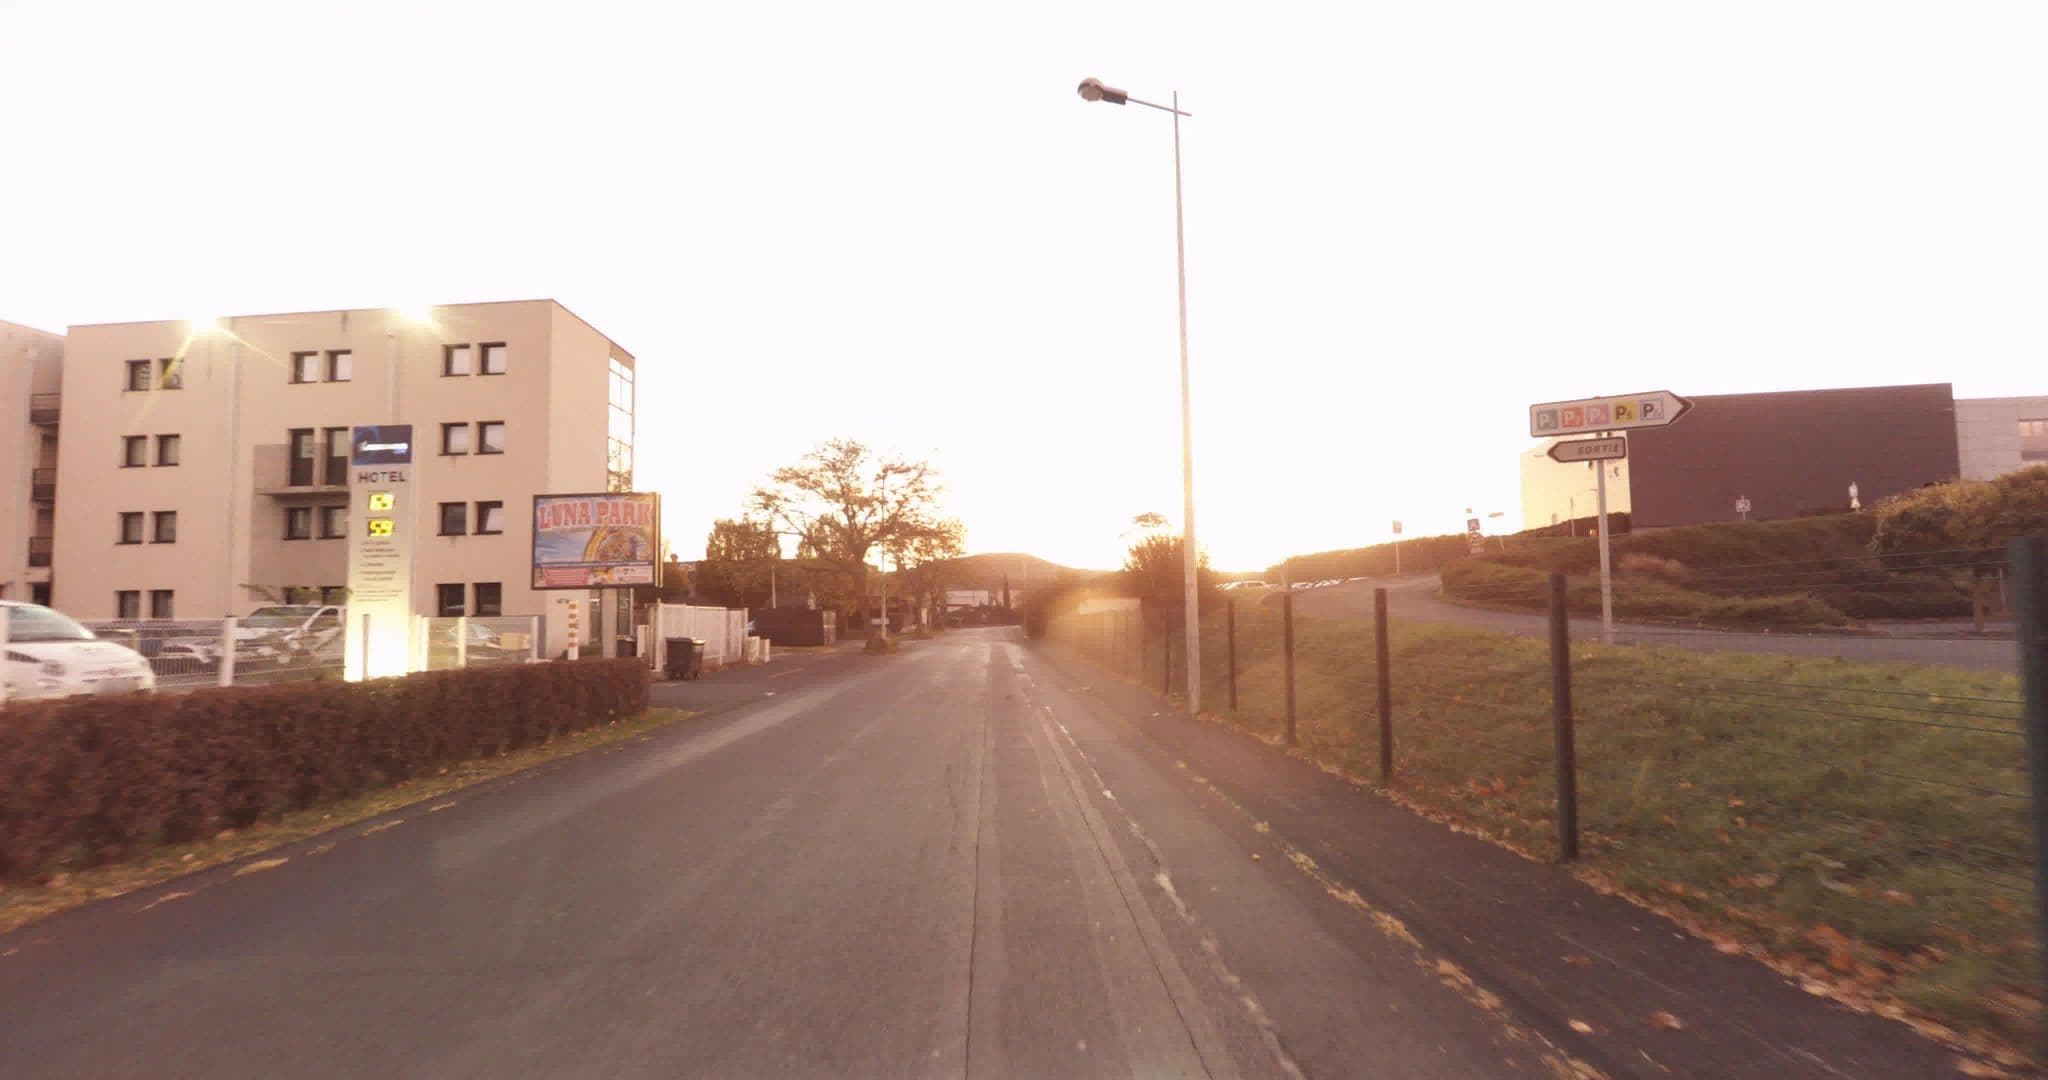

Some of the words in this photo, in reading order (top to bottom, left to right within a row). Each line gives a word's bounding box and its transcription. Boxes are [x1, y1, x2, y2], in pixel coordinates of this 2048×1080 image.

[1577, 442, 1619, 456] SORTIE
[358, 471, 407, 483] HOTEL
[539, 500, 593, 529] LUNA
[597, 500, 653, 526] PARK
